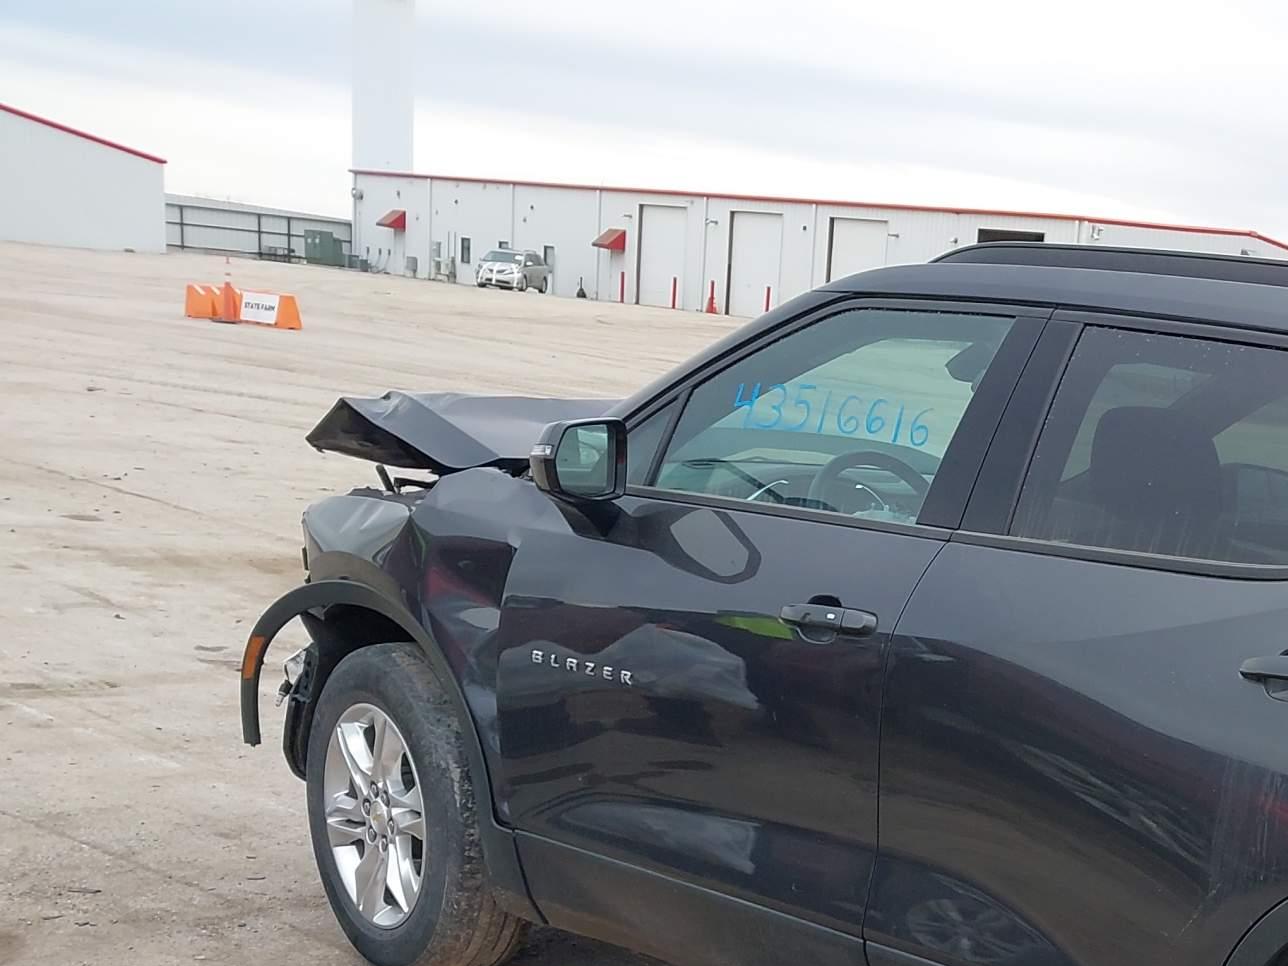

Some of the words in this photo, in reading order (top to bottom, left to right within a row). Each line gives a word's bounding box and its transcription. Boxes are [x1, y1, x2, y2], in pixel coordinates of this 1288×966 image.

[244, 302, 260, 311] STATE
[261, 303, 276, 311] FARM
[735, 382, 935, 447] 43516616
[531, 649, 633, 686] BLAZER
